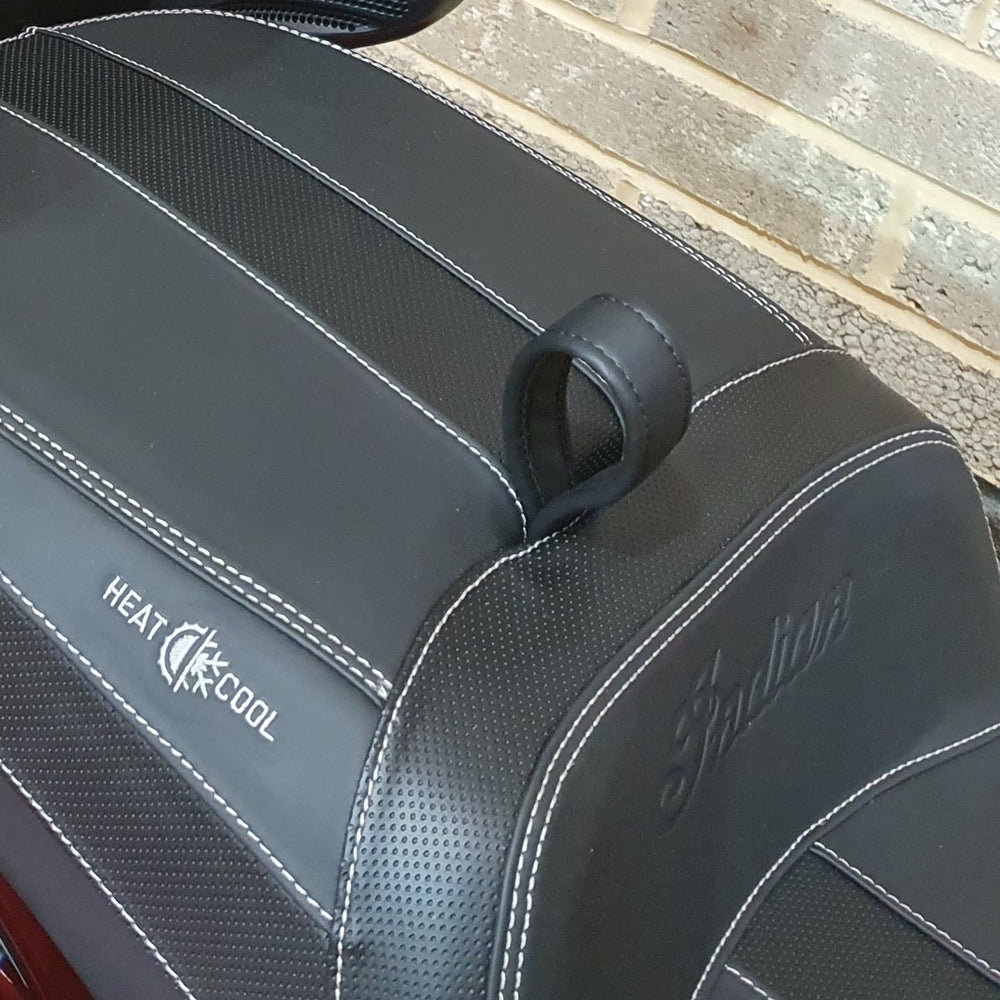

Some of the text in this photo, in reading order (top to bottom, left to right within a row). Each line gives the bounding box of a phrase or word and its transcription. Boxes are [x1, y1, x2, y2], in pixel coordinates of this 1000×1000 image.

[102, 575, 278, 743] HEAT COOL
[660, 577, 853, 820] Indian
